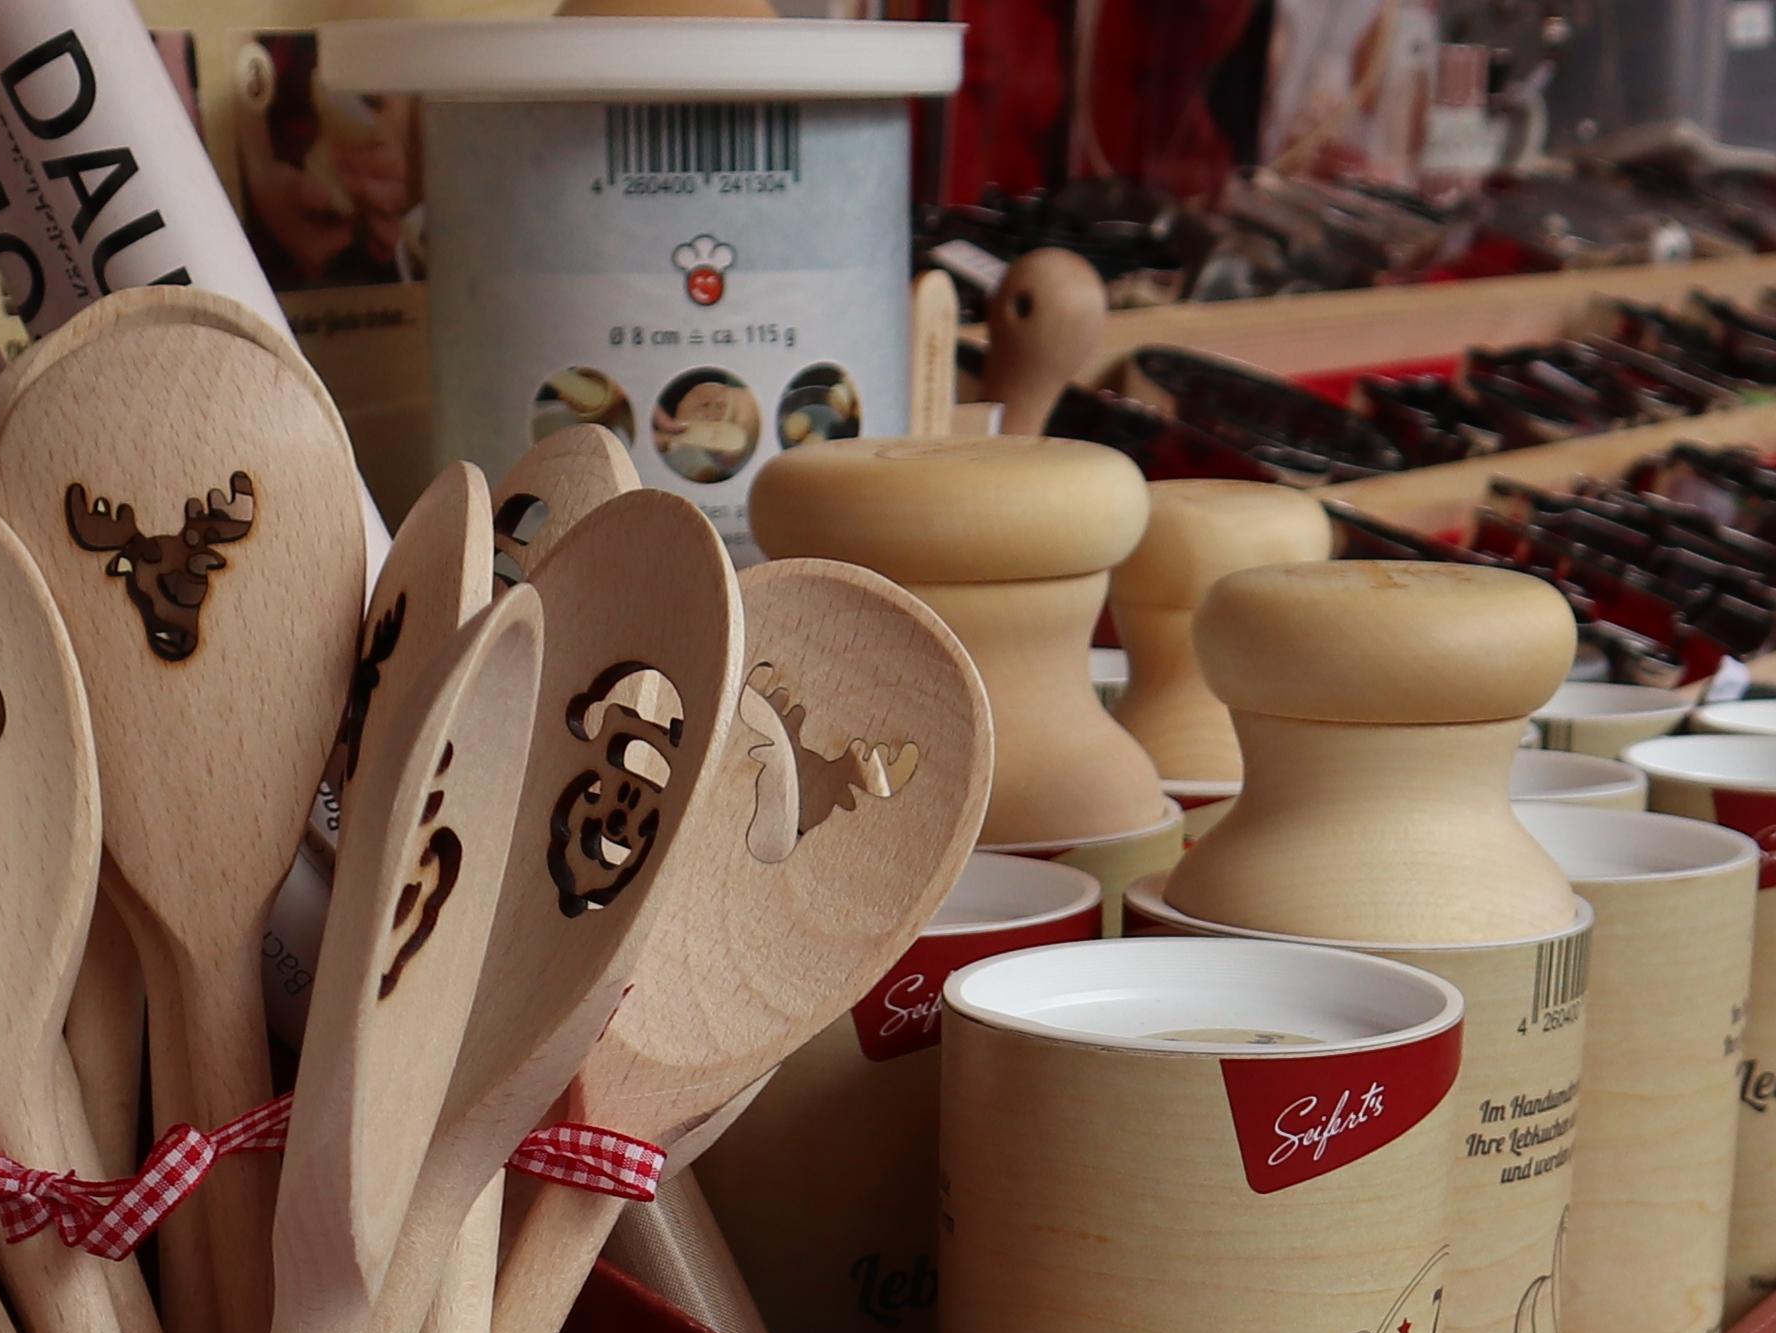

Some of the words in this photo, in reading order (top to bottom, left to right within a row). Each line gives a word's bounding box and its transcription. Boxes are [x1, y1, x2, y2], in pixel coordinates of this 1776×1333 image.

[651, 329, 680, 345] cm
[745, 324, 778, 343] 115
[1517, 1017, 1528, 1036] 4
[1268, 1081, 1385, 1166] Seifert's
[1479, 1099, 1506, 1124] Im
[1465, 1132, 1506, 1158] Ihre
[1500, 1157, 1534, 1185] und
